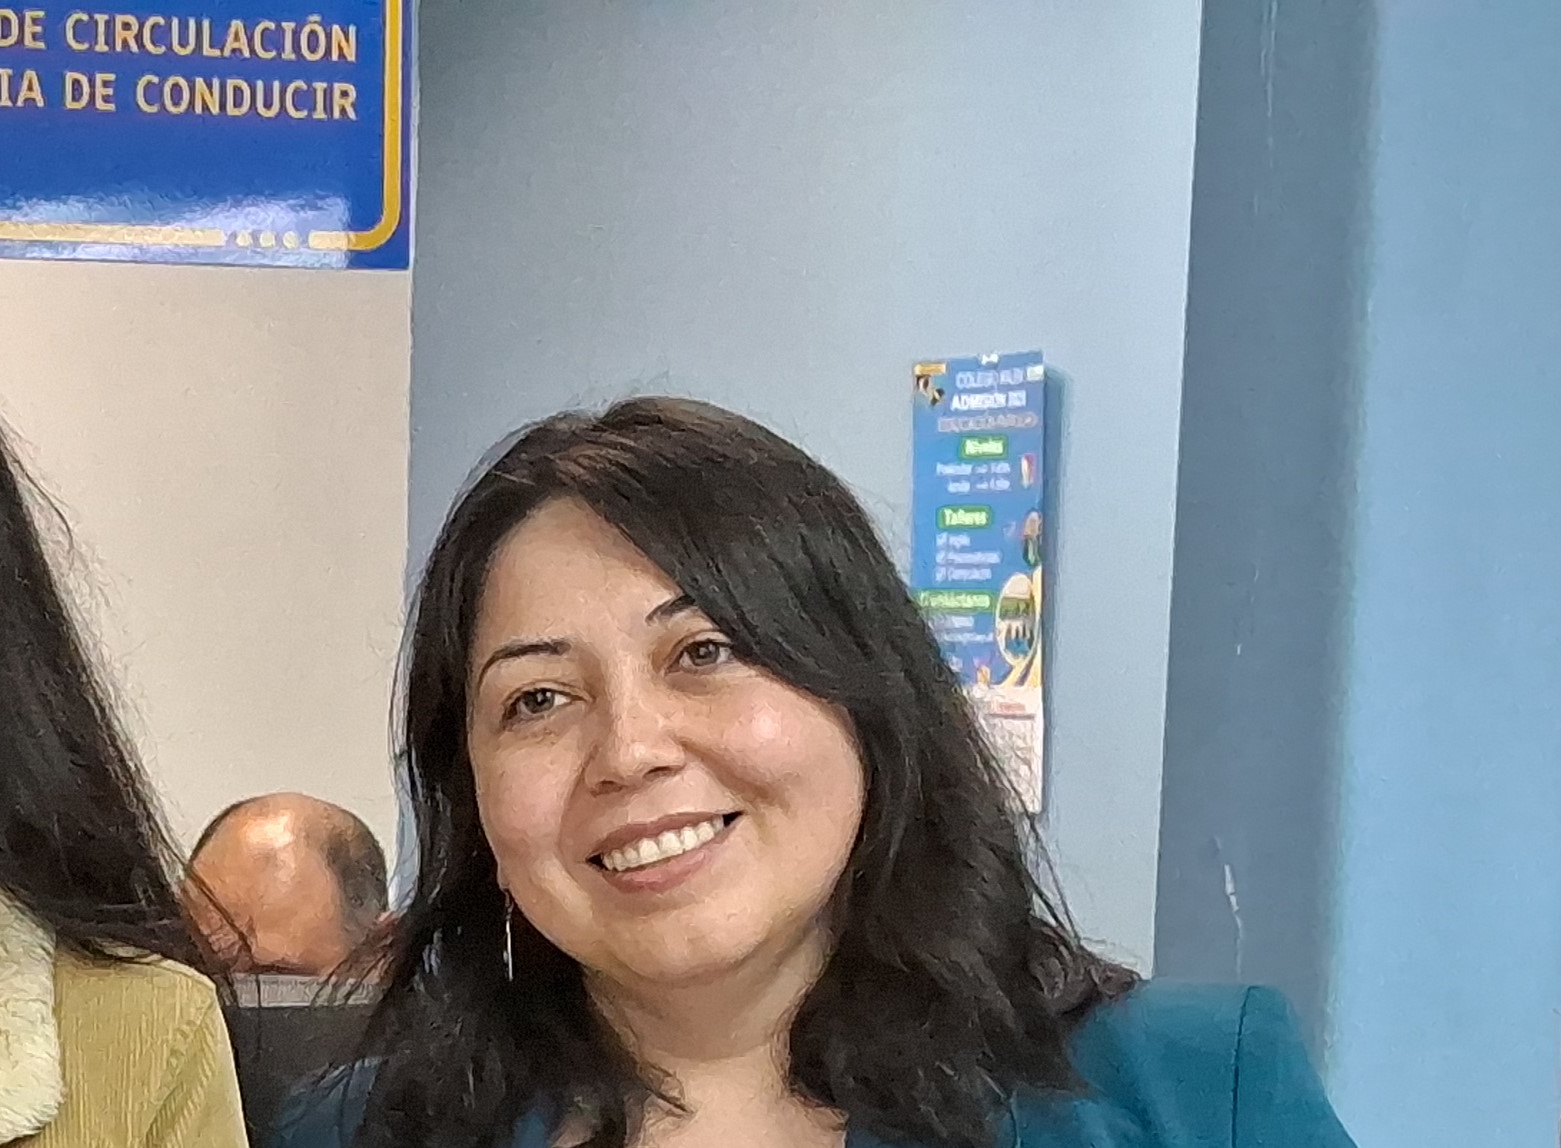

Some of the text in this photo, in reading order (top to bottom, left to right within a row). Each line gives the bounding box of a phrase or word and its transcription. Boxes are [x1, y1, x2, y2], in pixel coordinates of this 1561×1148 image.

[64, 12, 358, 62] CIRCULACIÓN
[64, 71, 117, 111] DE
[136, 74, 358, 120] CONDUCIR
